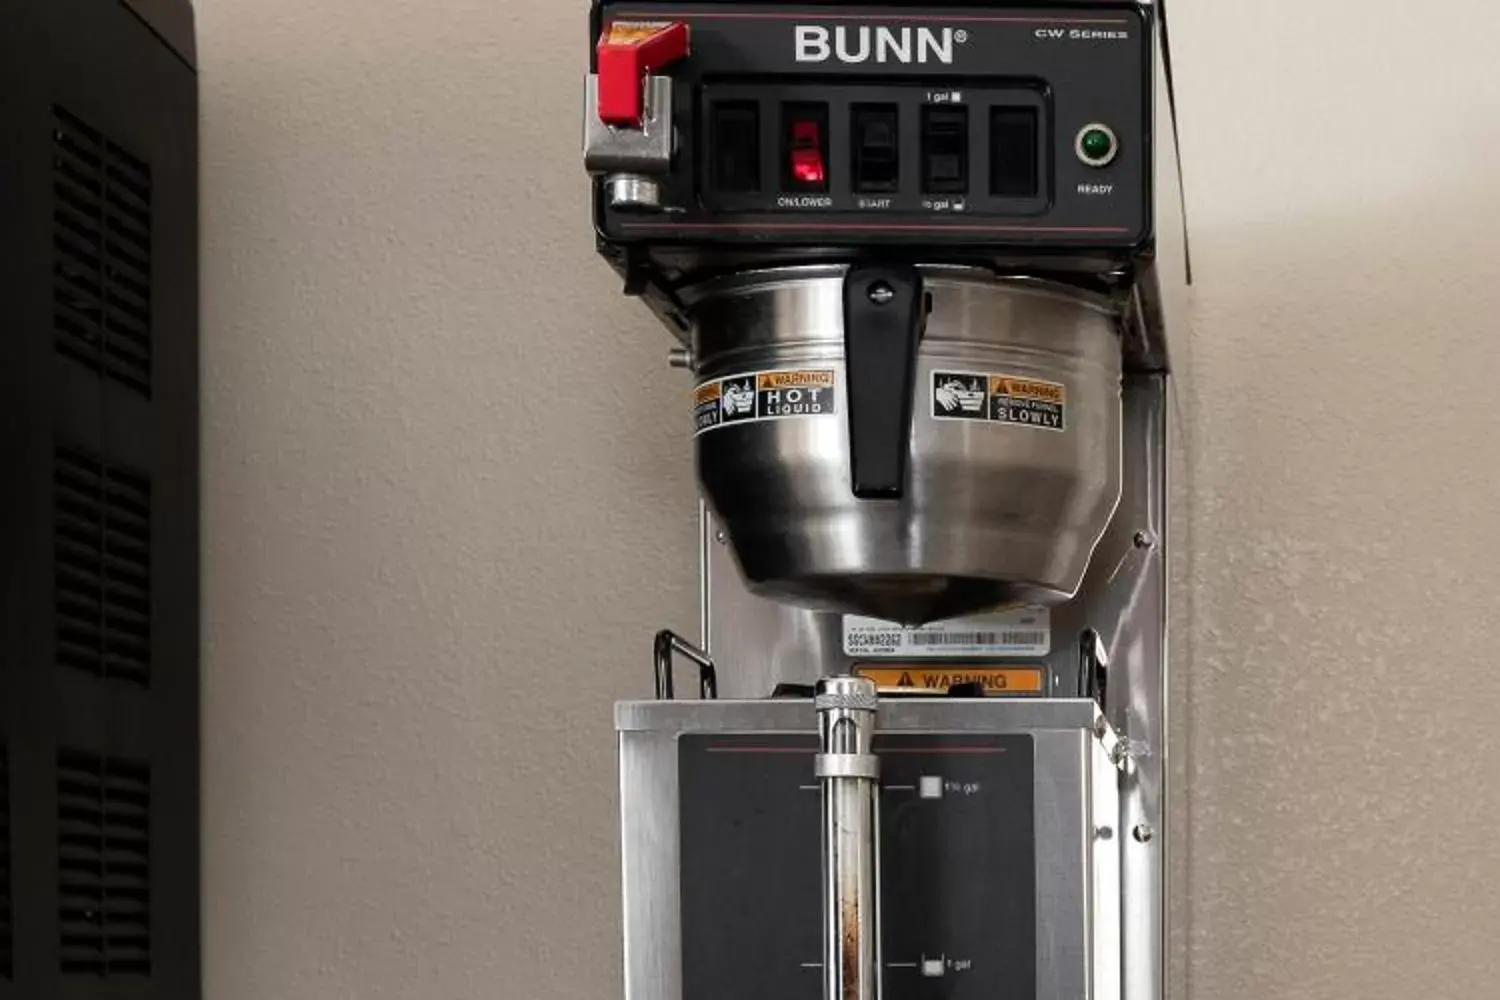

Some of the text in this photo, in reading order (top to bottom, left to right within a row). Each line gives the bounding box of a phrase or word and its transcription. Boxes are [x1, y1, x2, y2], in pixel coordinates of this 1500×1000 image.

[1077, 184, 1114, 195] READY
[767, 387, 822, 404] HOT
[767, 403, 821, 415] LIQUID
[997, 406, 1059, 427] SLOWLY
